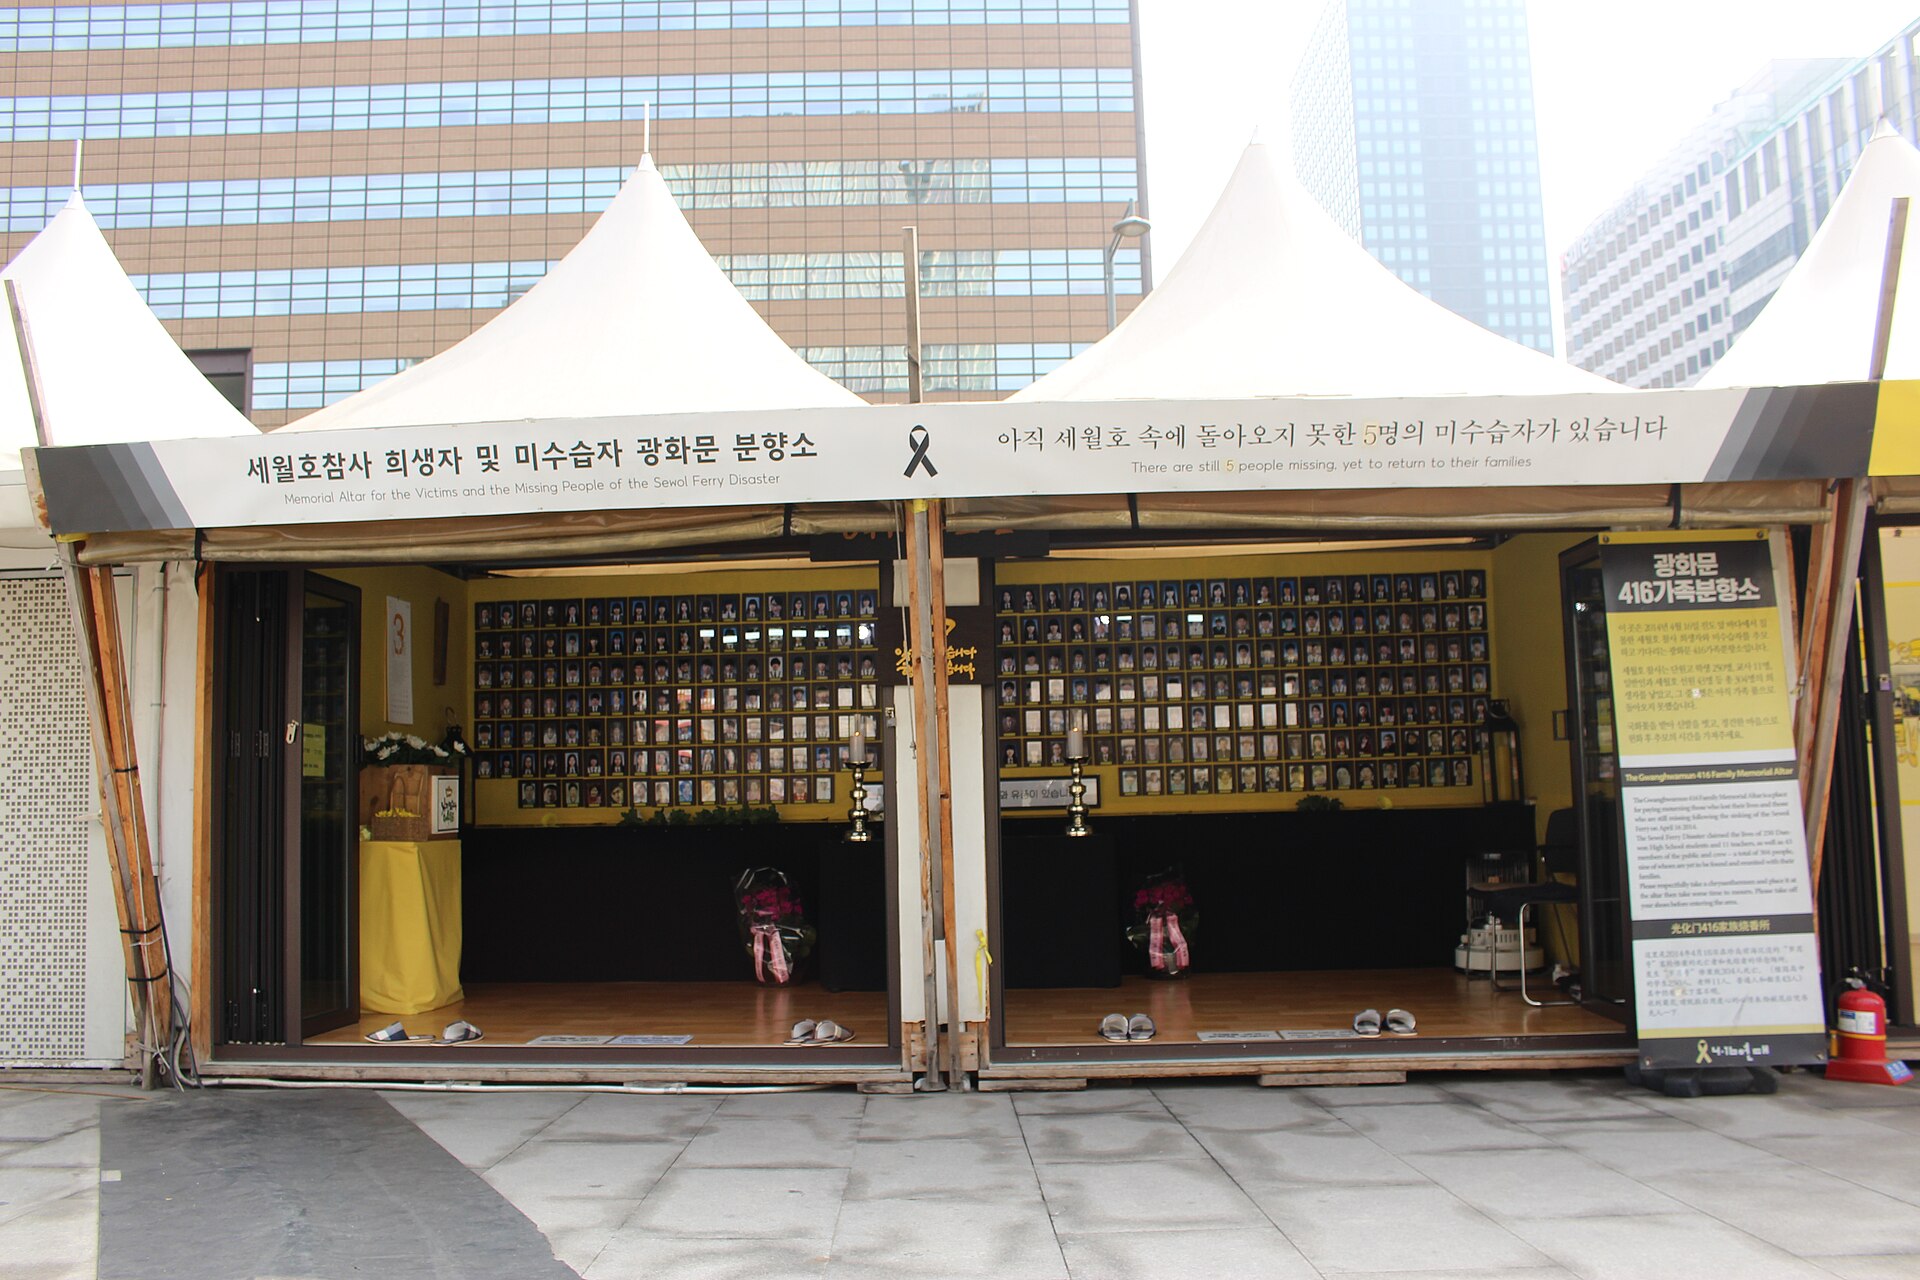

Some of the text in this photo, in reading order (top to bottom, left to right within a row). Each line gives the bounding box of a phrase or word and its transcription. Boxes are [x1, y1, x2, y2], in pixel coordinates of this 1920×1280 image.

[998, 415, 1667, 452] 아직 세월호 속에 돌아오지 못한 5명의 미수습자가 있습니다
[248, 432, 817, 484] 세월호참사 희생자 및 미수습자 광화문 분향소
[1132, 456, 1532, 475] There are still 5 people missing, yet to return to their families
[285, 473, 780, 504] Memorial Altar for the Victims and the Missing People of the Sewol Ferry Disaster
[1653, 552, 1719, 577] 광화문
[1618, 577, 1761, 605] 416가족분향소
[393, 613, 404, 655] 3
[1625, 773, 1638, 781] The
[1697, 771, 1711, 779] 416
[1712, 770, 1735, 780] Family
[1737, 768, 1773, 777] Memorial
[1774, 767, 1793, 776] Altar
[1041, 788, 1073, 799] 있습니
